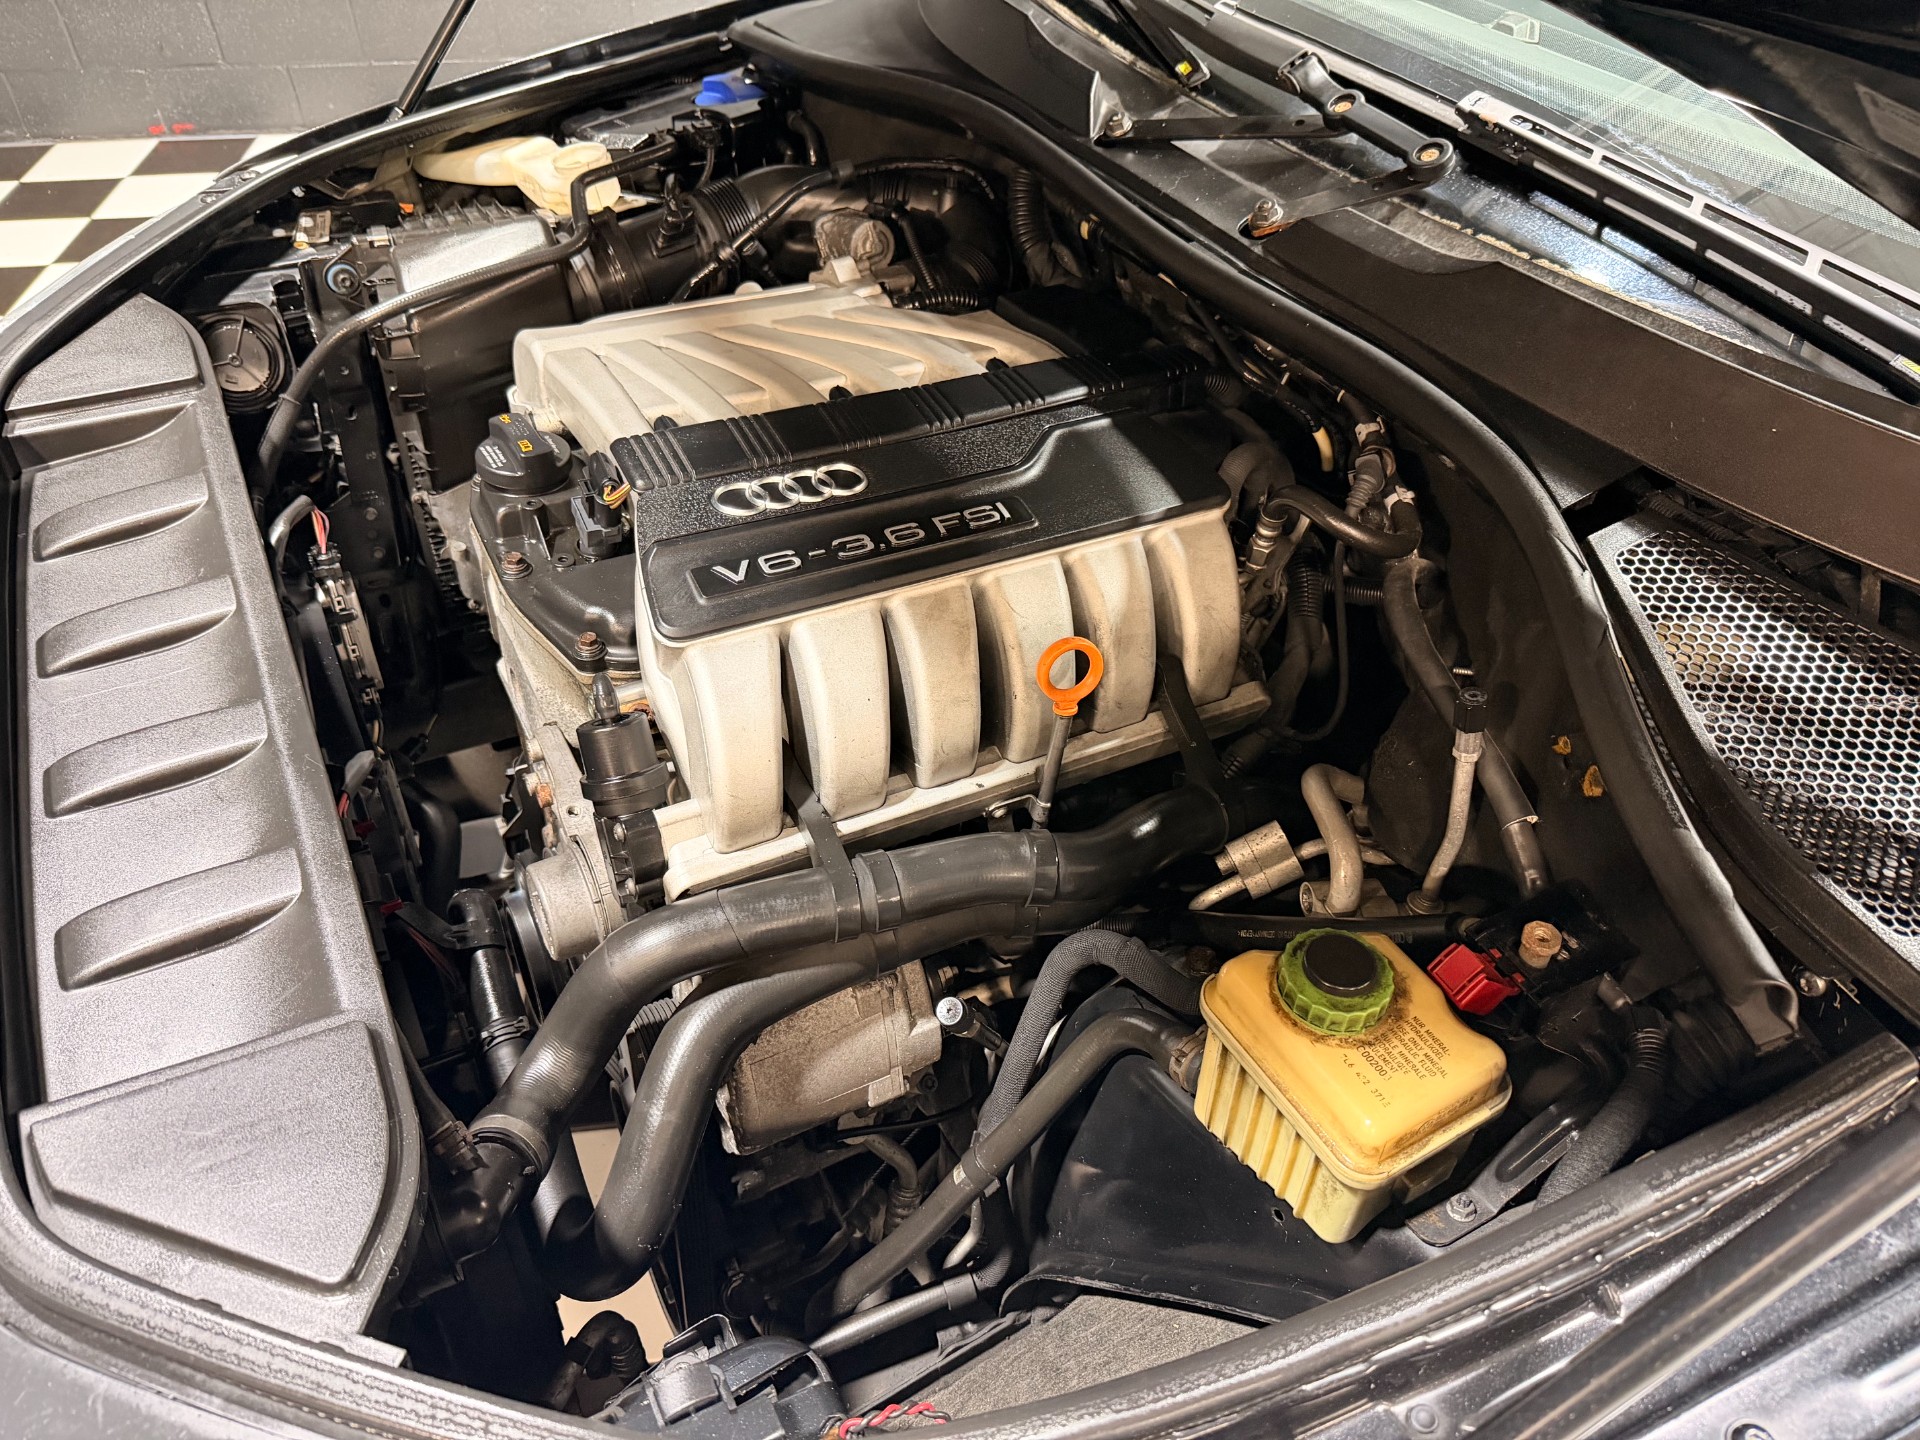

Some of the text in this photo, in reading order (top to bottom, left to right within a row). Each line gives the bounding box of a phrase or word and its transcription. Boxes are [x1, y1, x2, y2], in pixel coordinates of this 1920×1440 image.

[931, 501, 1011, 537] FSI
[1367, 1040, 1400, 1074] SEULEMENT
[1380, 1032, 1427, 1081] HUILE MINERALE
[1389, 1027, 1438, 1078] HYDRAULIC FLUID
[1395, 1024, 1449, 1079] USE ONLY MINERAL
[1404, 1019, 1445, 1061] HYDRAULIKOEL
[1411, 1015, 1451, 1057] NUR MINERAL-
